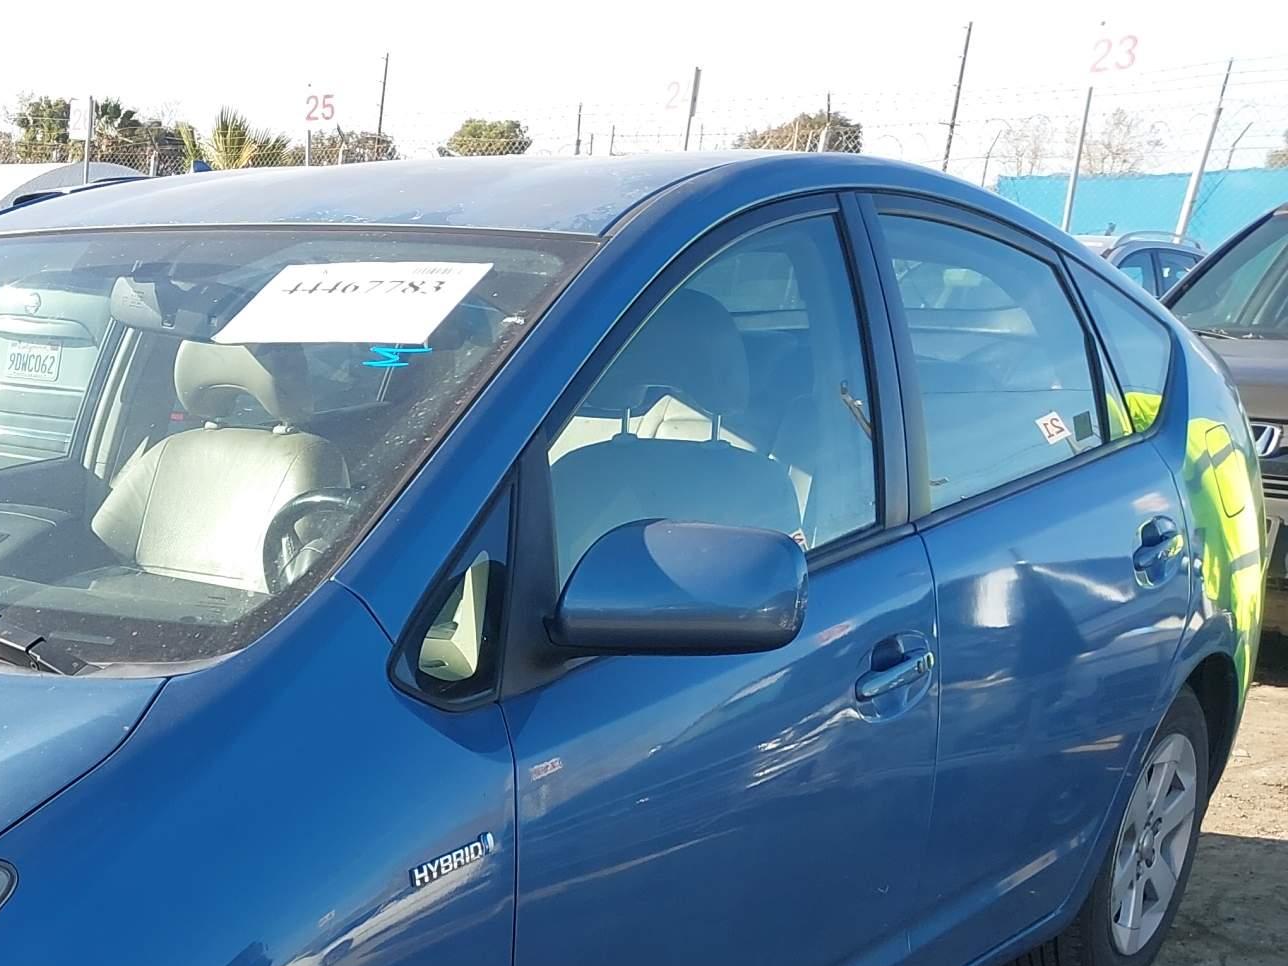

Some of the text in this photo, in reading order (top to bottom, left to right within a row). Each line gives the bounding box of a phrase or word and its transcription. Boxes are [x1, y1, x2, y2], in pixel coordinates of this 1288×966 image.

[1090, 35, 1138, 72] 23
[305, 94, 335, 122] 25
[7, 352, 56, 375] 9DWC062
[412, 840, 485, 887] HYBRID
